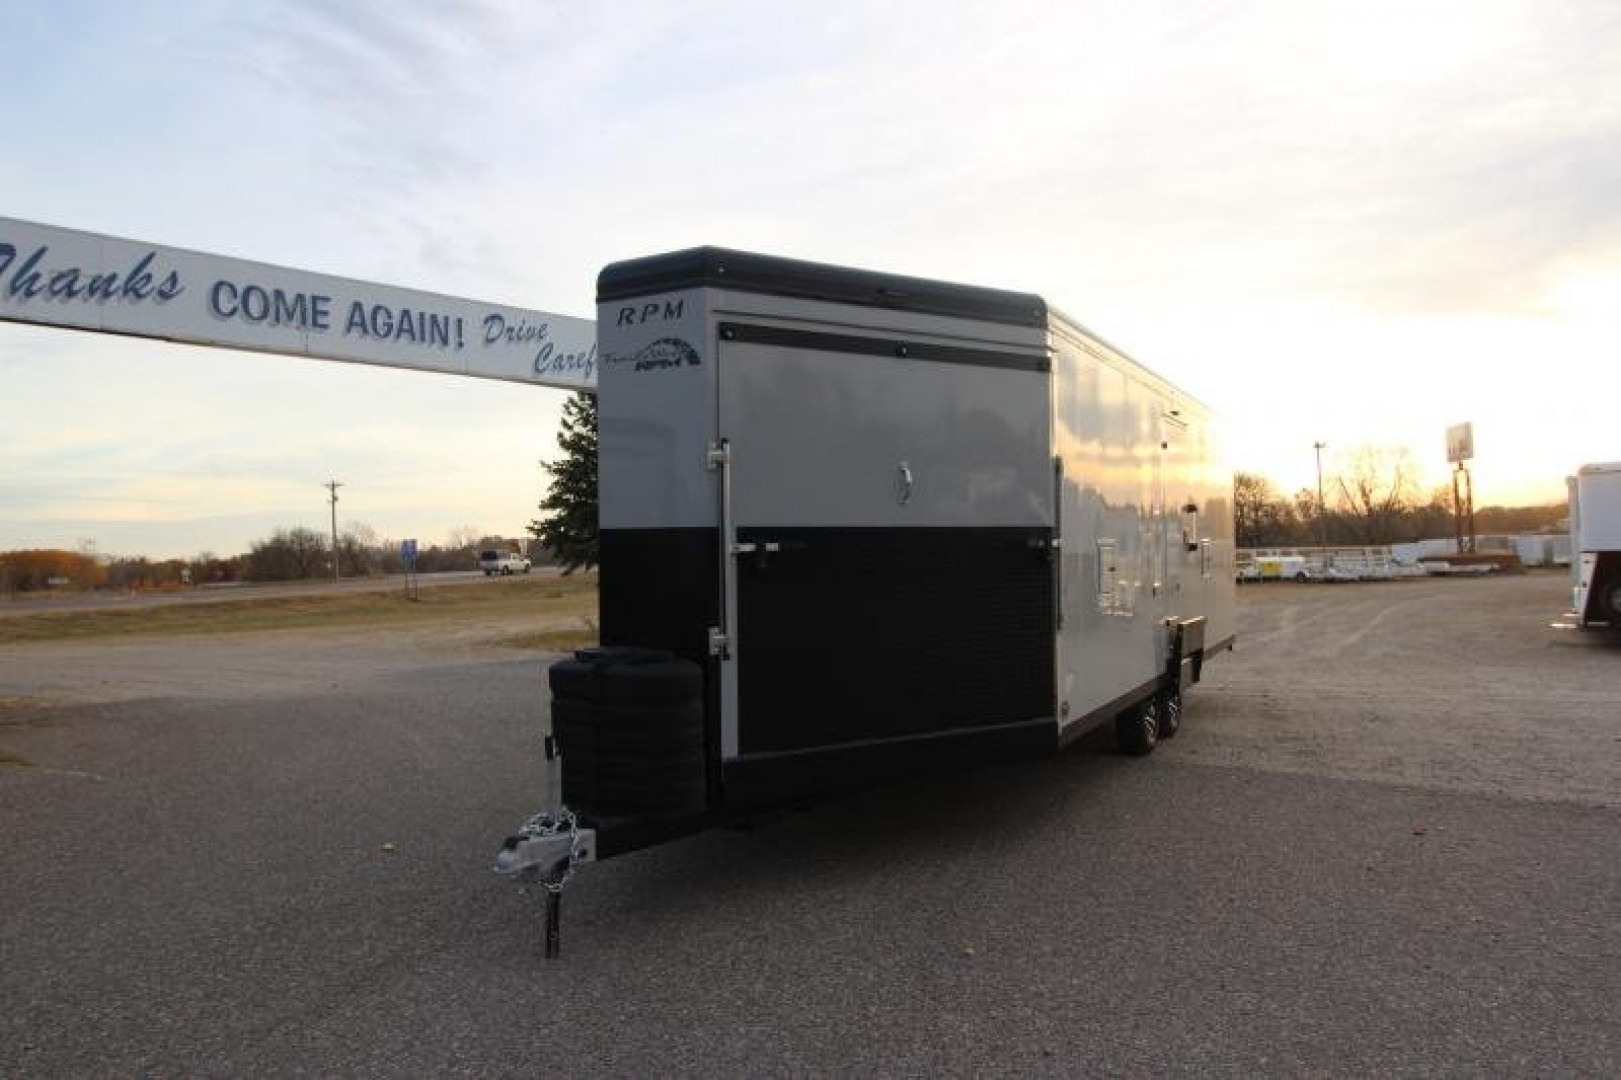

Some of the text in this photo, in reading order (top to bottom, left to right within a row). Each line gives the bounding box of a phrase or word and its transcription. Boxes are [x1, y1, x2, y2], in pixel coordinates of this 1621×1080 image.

[210, 279, 332, 332] COME
[345, 301, 465, 350] AGAIN!
[483, 313, 551, 344] Drive
[533, 342, 597, 379] Caref
